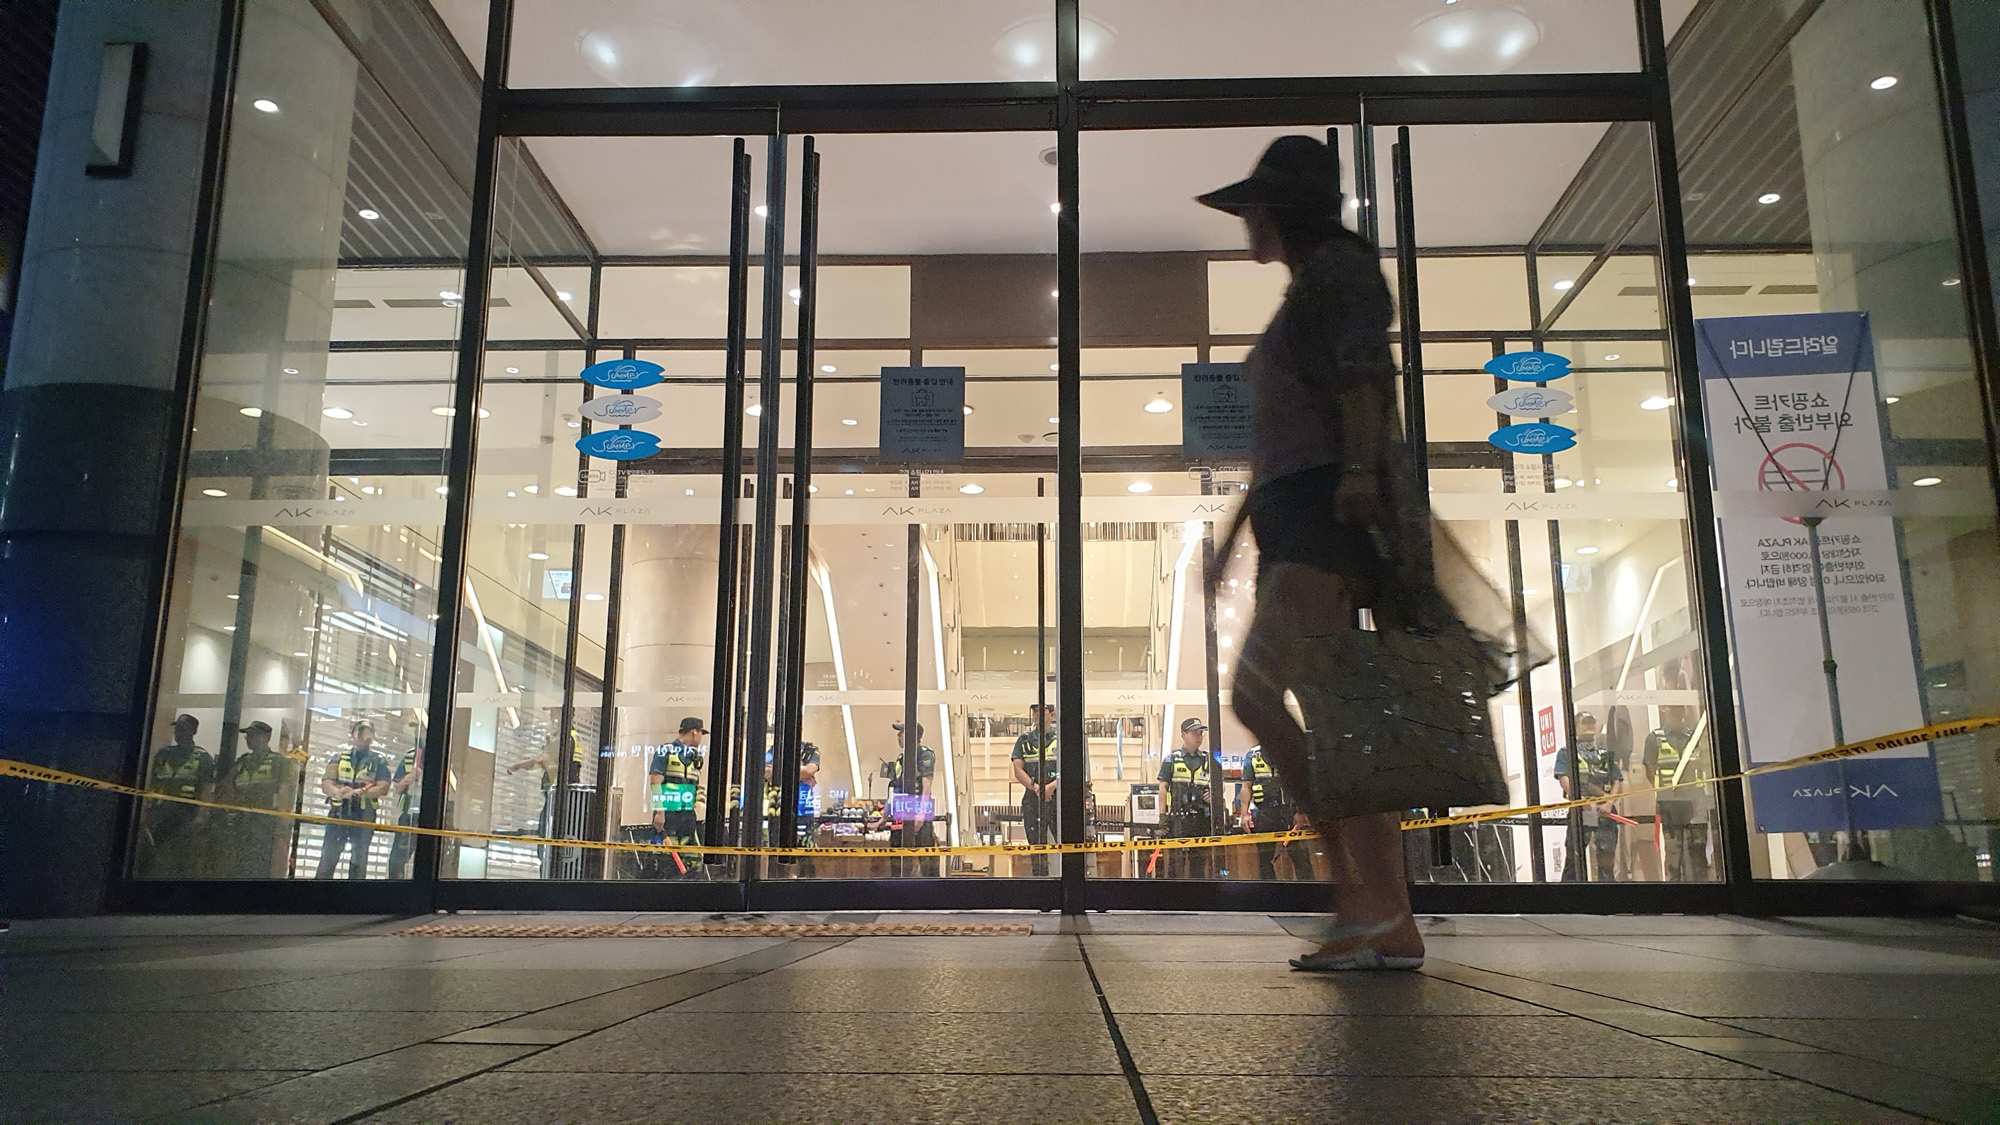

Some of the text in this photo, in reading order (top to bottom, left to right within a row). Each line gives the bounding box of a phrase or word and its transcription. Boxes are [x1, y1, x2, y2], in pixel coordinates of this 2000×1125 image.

[1192, 503, 1226, 513] AK
[1505, 501, 1539, 511] AK
[1816, 498, 1851, 508] AK
[274, 507, 312, 518] AK
[579, 506, 613, 516] AK
[882, 506, 914, 515] AK
[1540, 712, 1552, 731] UNI
